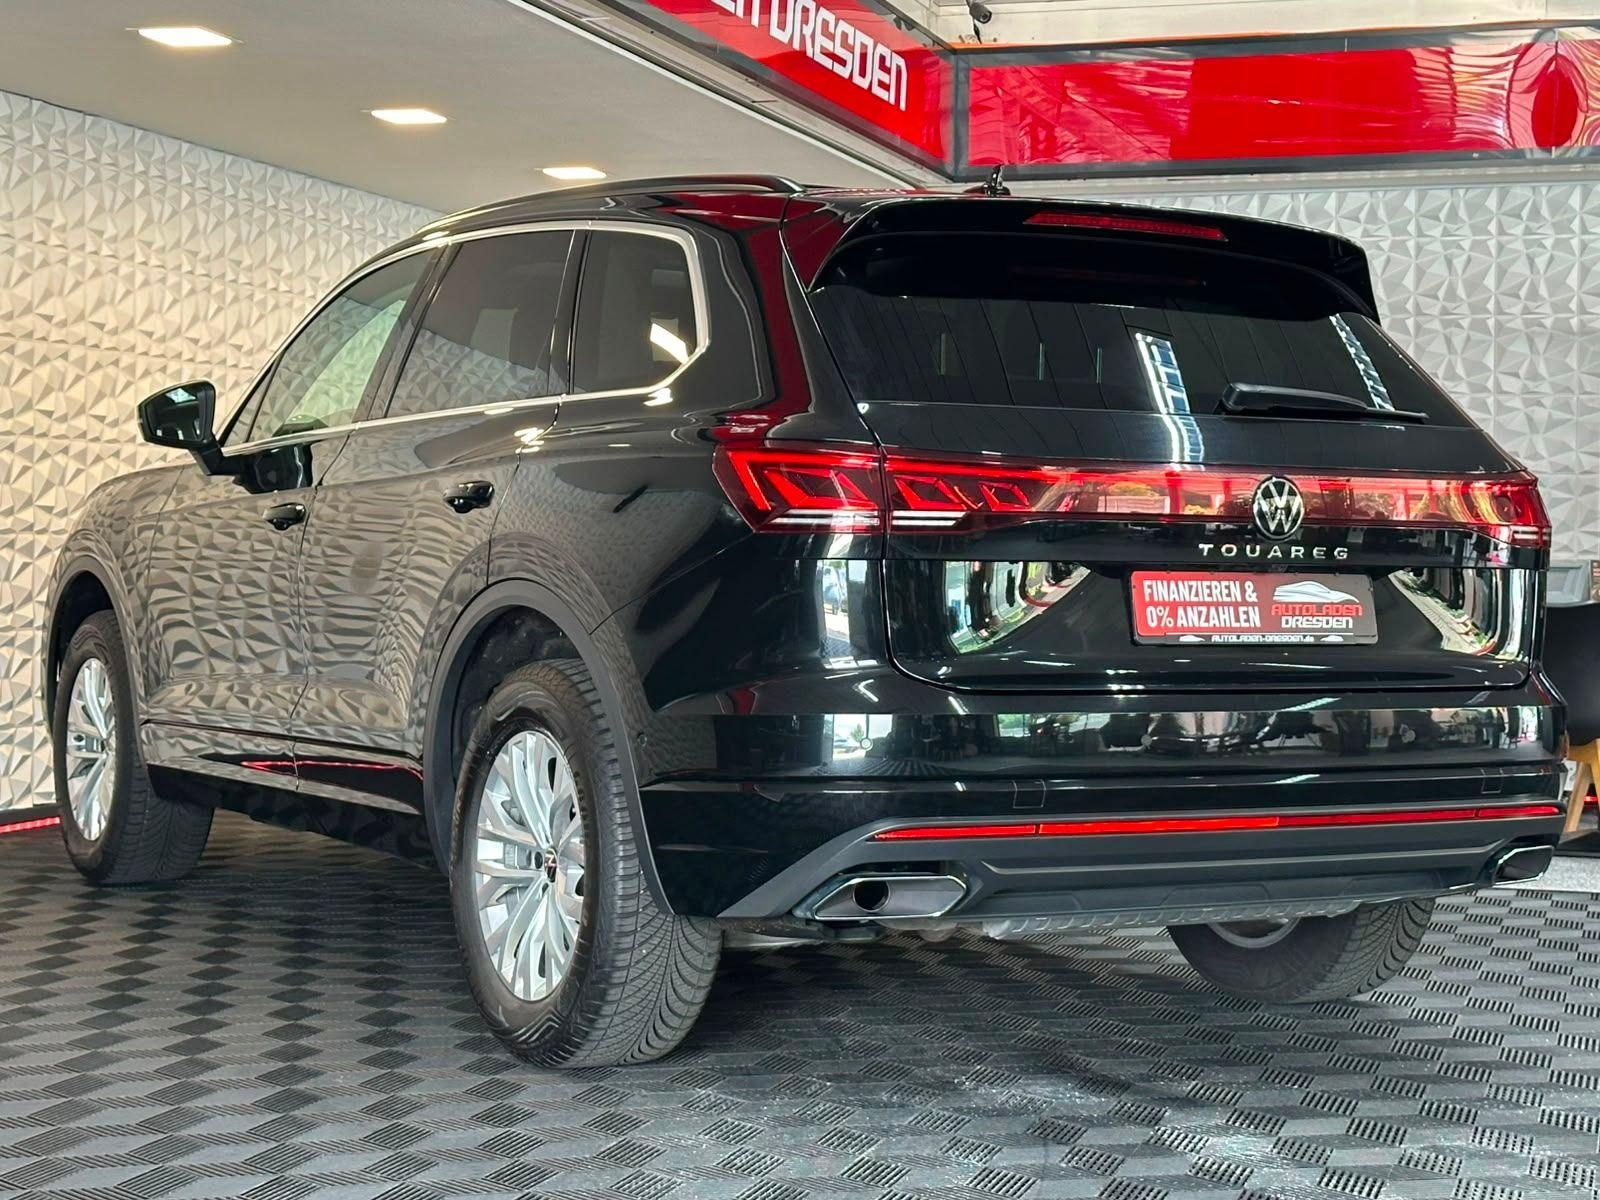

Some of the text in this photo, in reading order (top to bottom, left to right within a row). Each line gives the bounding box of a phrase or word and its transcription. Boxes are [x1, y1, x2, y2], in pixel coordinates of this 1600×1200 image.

[769, 0, 907, 111] DRESDEN
[1199, 544, 1349, 560] TOUAREG
[1143, 580, 1258, 602] FINANZIEREN &
[1146, 606, 1261, 628] 0% ANZAHLEN
[1271, 604, 1362, 616] AUTOLADEN
[1281, 616, 1353, 629] DRESDEN
